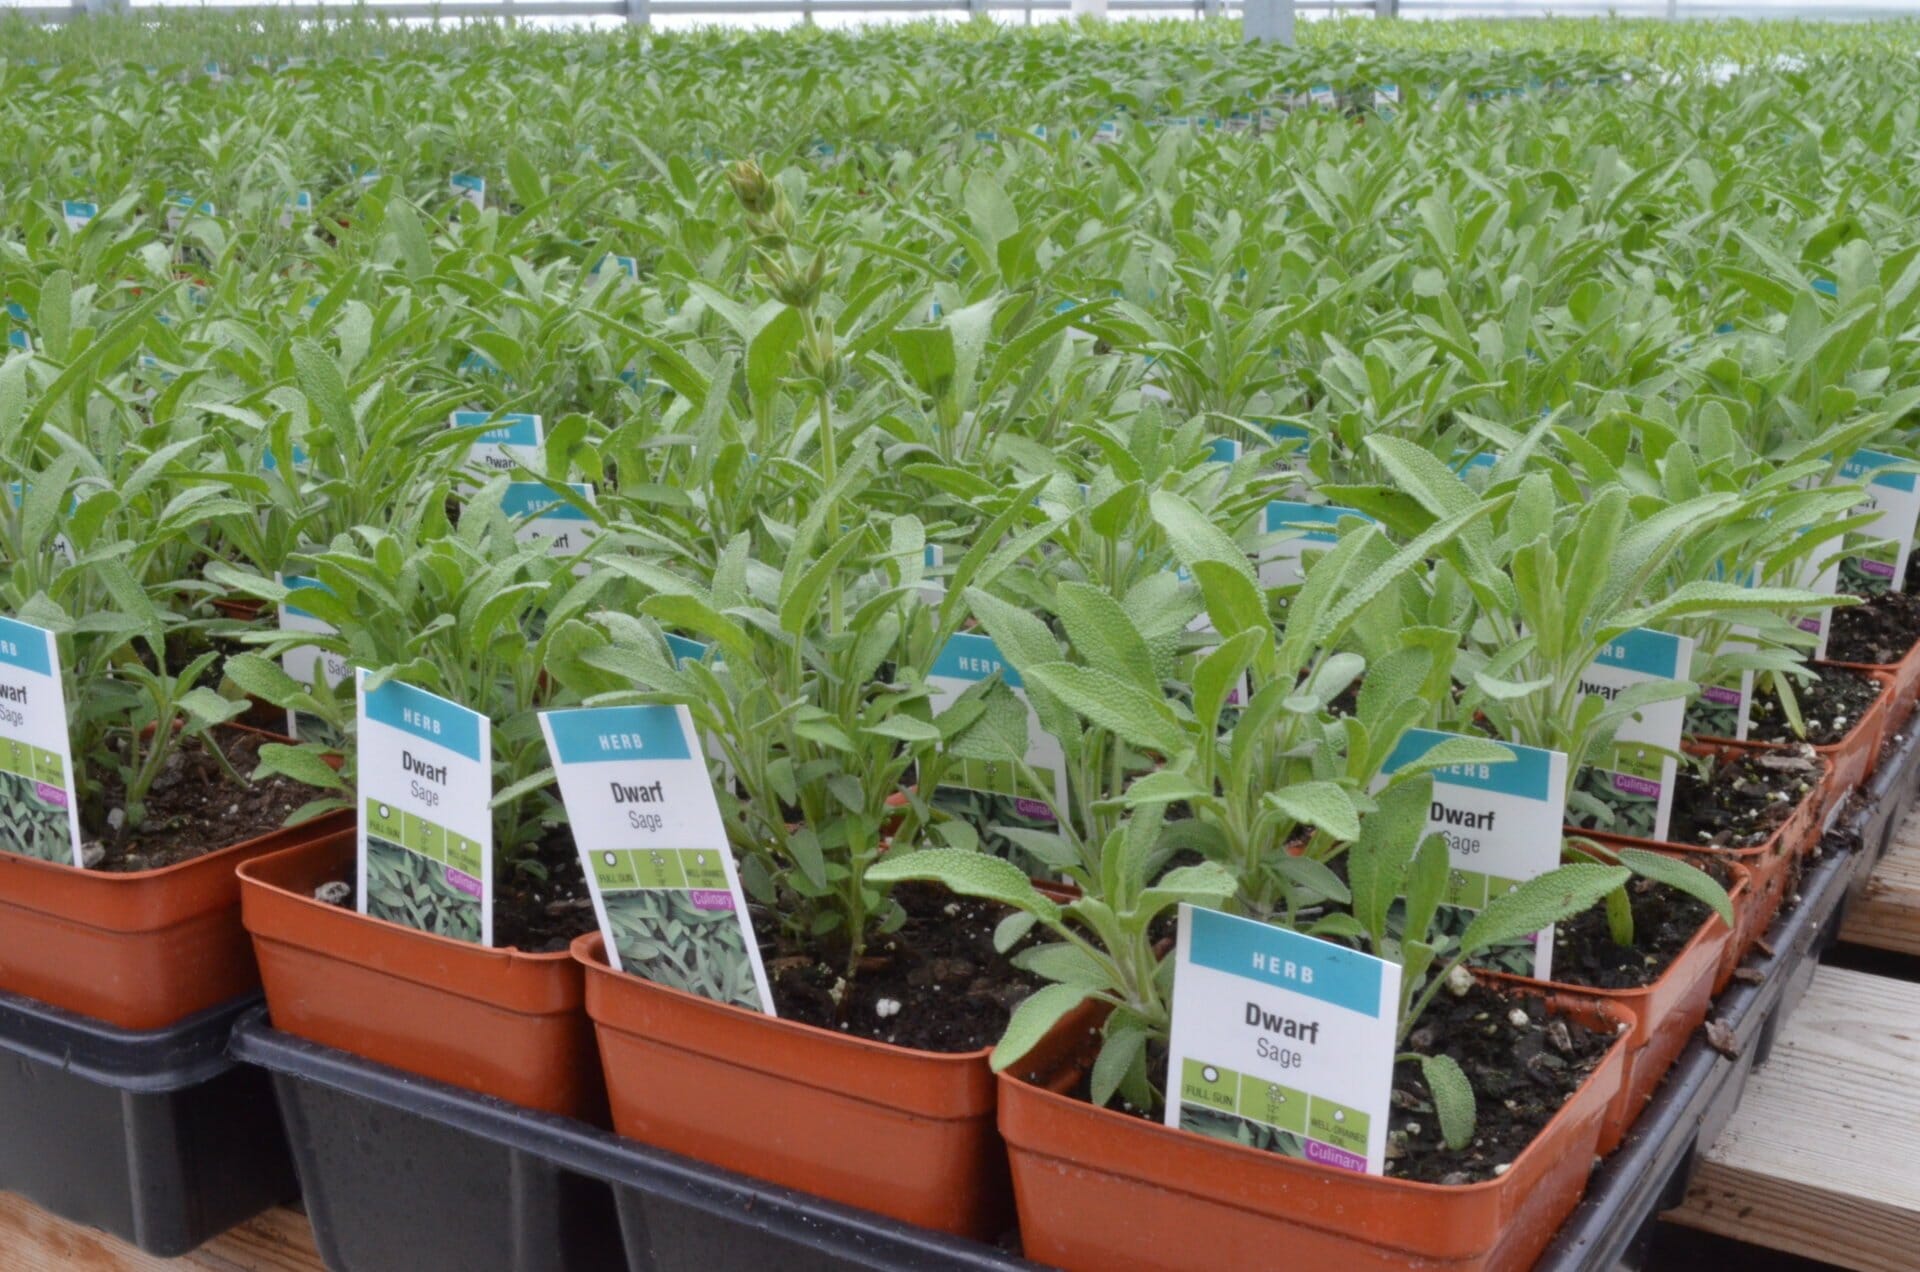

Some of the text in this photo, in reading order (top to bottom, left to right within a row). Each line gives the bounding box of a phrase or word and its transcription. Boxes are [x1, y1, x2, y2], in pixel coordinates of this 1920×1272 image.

[0, 640, 17, 656] RB
[0, 684, 27, 704] warf
[1578, 680, 1628, 701] war
[403, 707, 441, 735] HERB
[599, 733, 644, 750] HERB
[402, 750, 447, 785] Dwarf
[411, 780, 439, 806] Sage
[610, 781, 664, 803] Dwarf
[628, 810, 663, 832] Sage
[1431, 802, 1495, 831] Dwarf
[693, 890, 732, 909] Culinary
[1252, 951, 1314, 984] HERB
[1245, 1002, 1320, 1045] Dwarf
[1256, 1037, 1302, 1068] Sage
[1186, 1084, 1234, 1107] FULL SUN
[1309, 1141, 1365, 1172] Culinary
